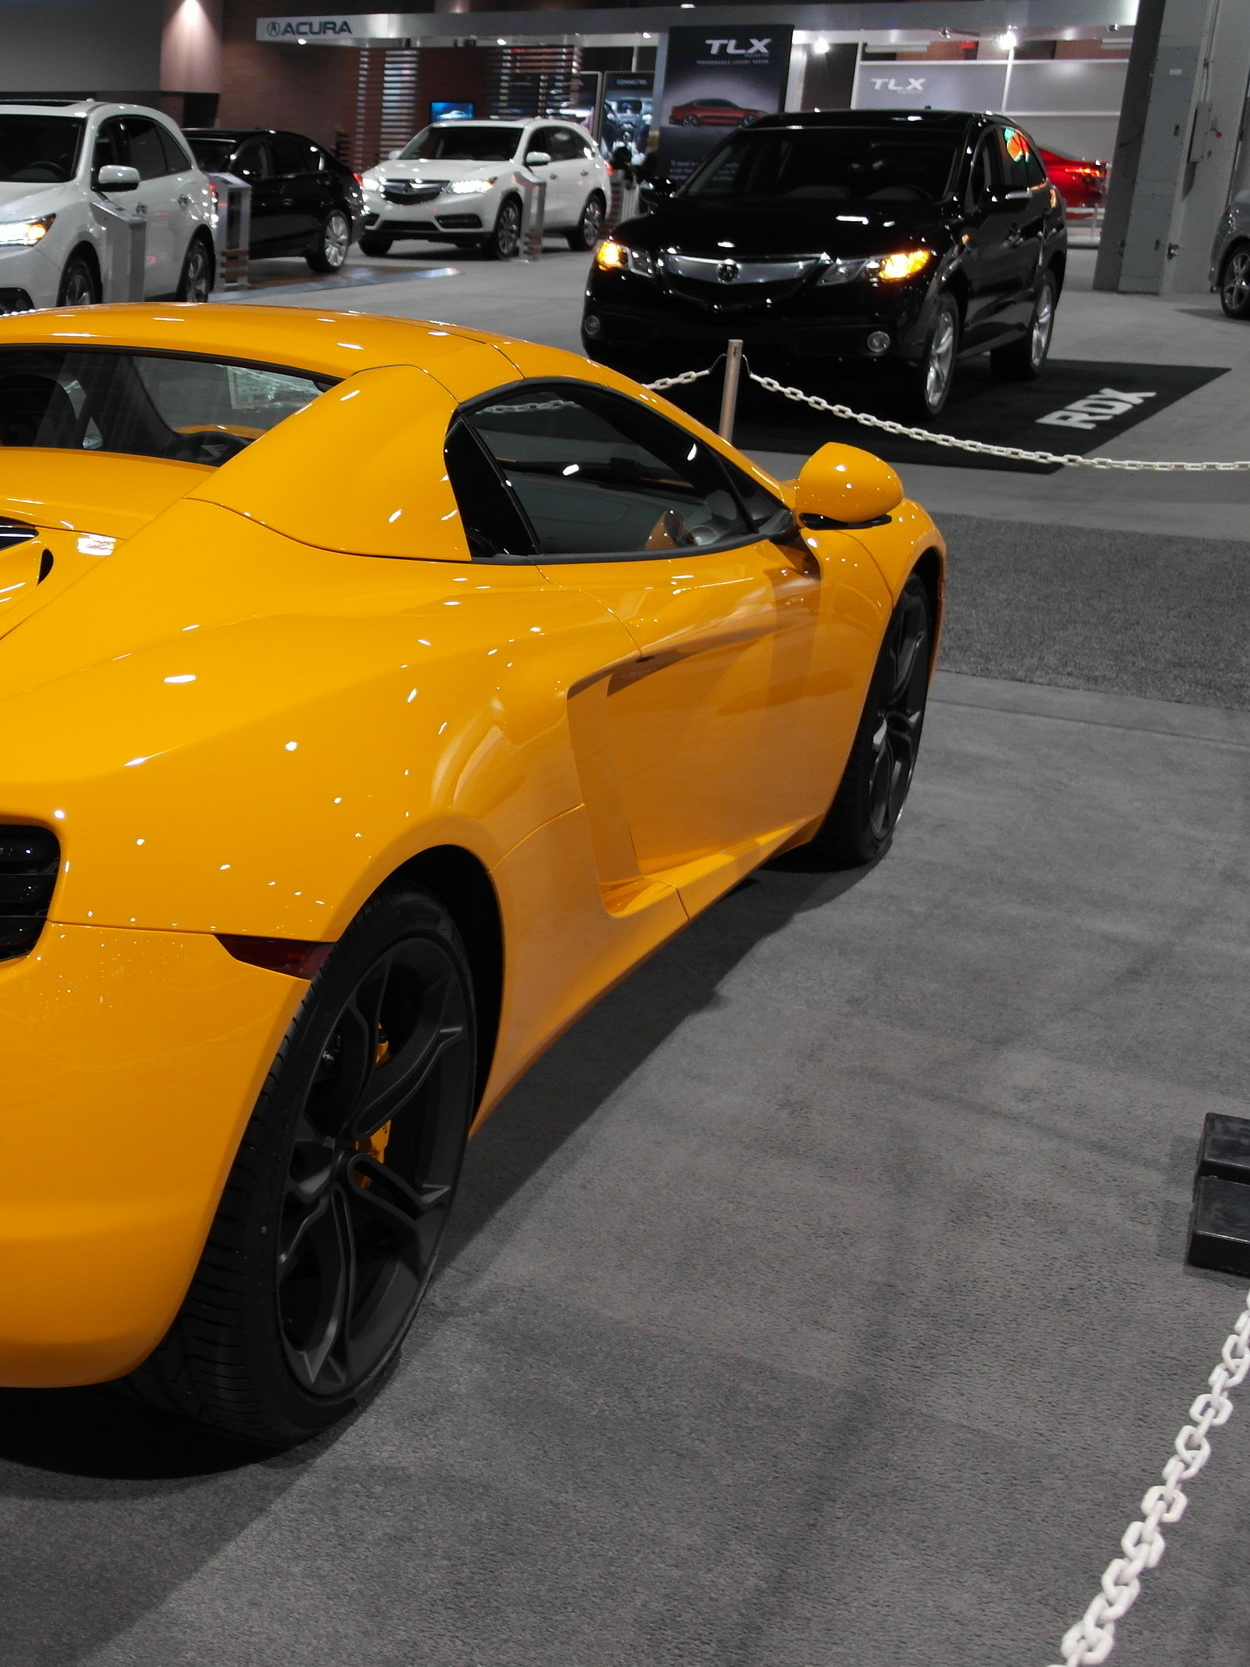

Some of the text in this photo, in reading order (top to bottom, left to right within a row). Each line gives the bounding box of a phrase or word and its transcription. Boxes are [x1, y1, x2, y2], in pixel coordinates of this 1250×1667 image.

[281, 20, 353, 36] ACURA
[705, 38, 772, 55] TLX
[870, 78, 926, 90] TLX
[1035, 388, 1157, 430] RDX
